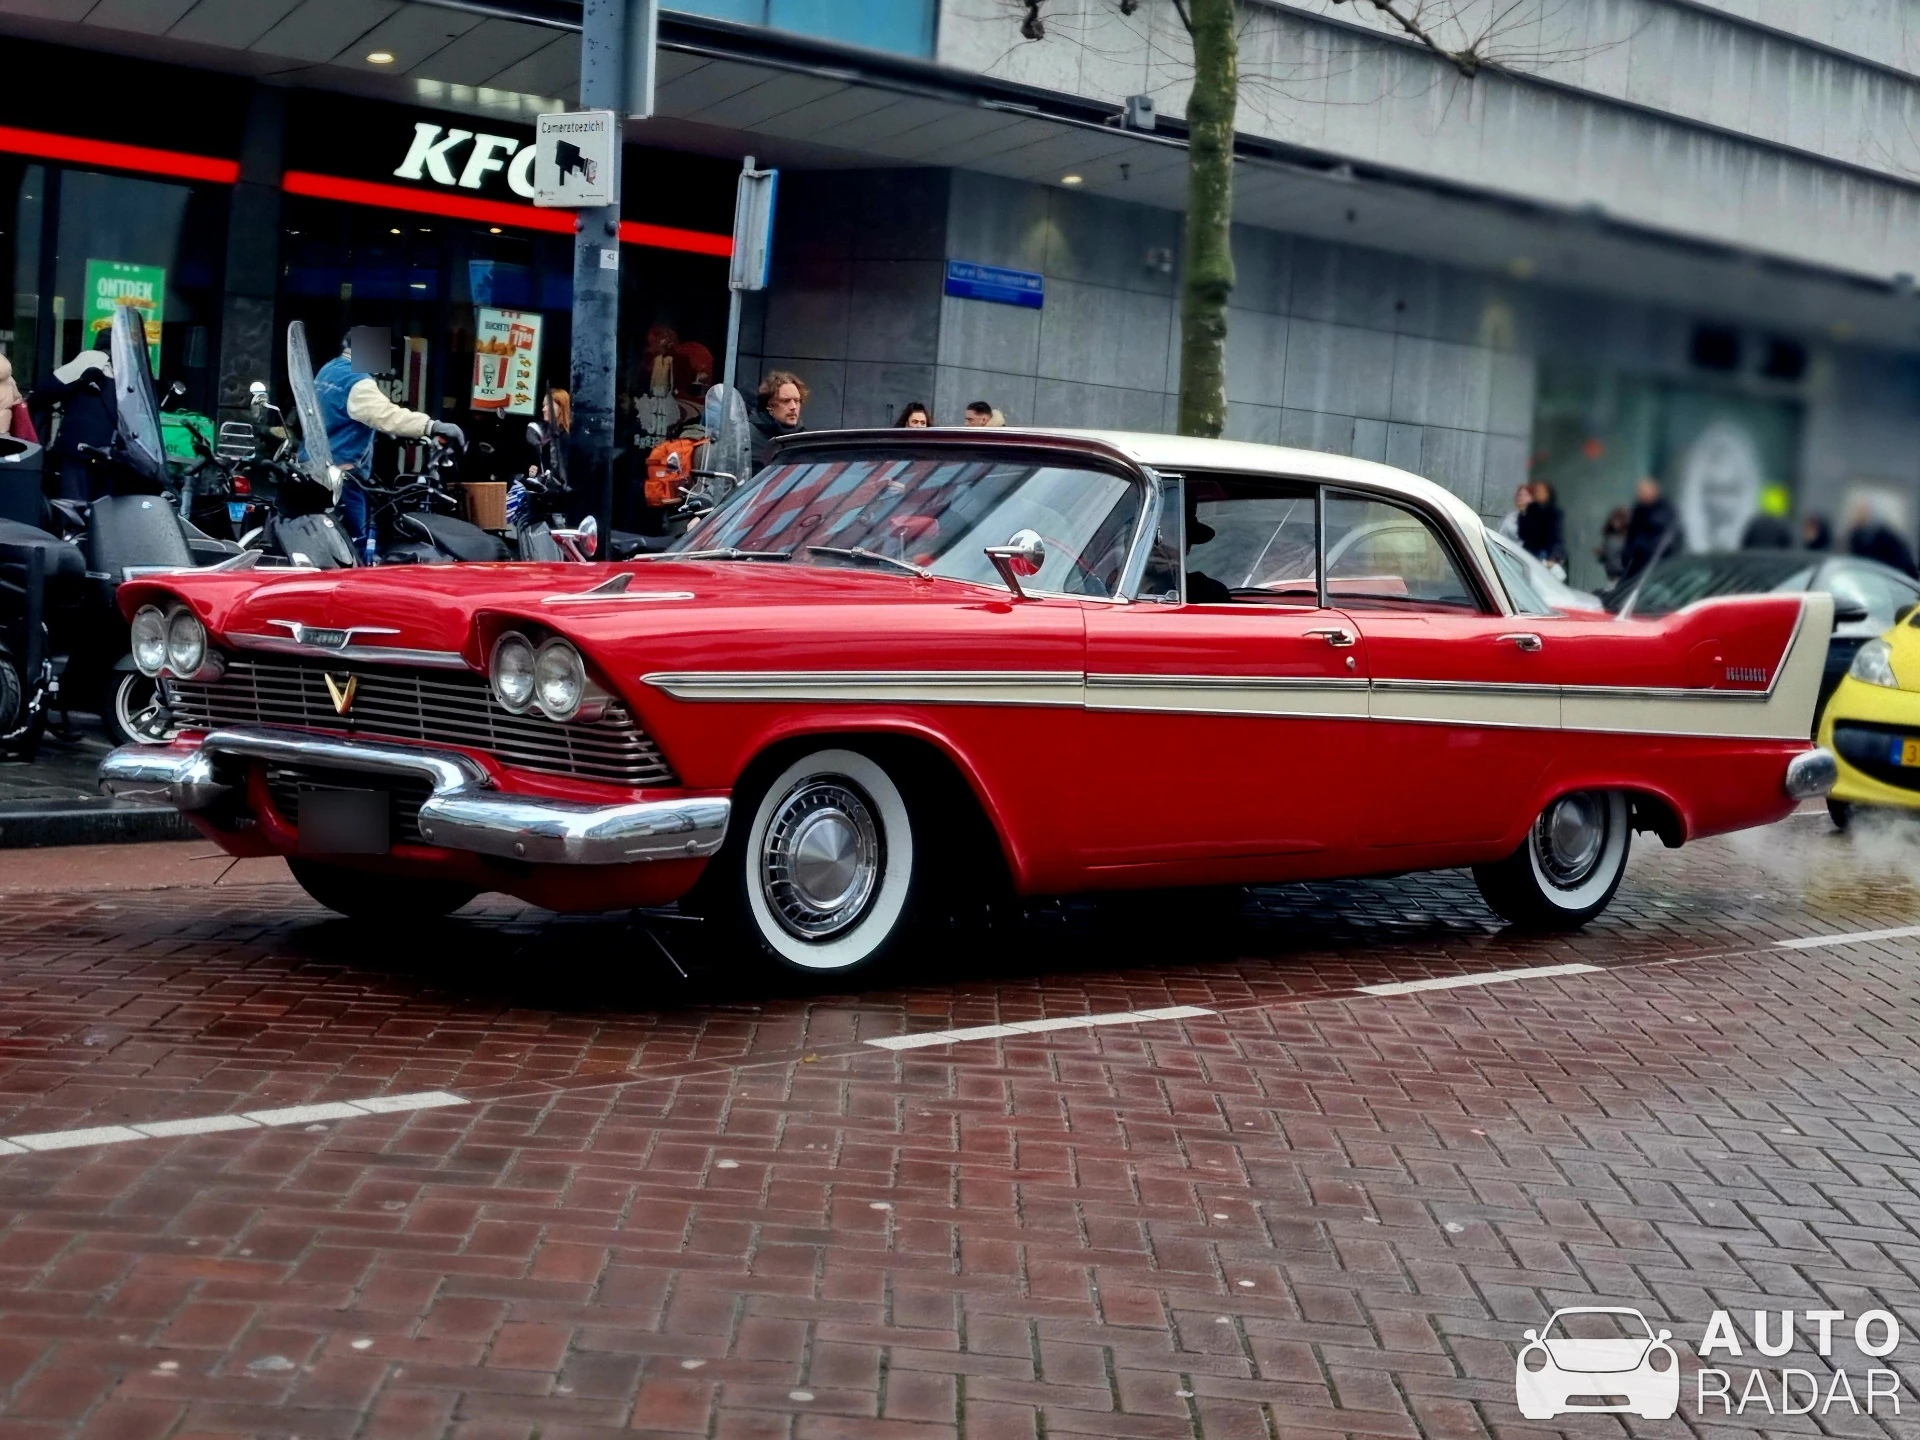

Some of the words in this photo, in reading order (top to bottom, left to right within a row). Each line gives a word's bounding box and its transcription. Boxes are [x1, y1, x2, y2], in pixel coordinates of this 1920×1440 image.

[541, 120, 604, 134] Cameratoezicht
[97, 277, 153, 301] ONTDEK
[166, 443, 179, 453] er
